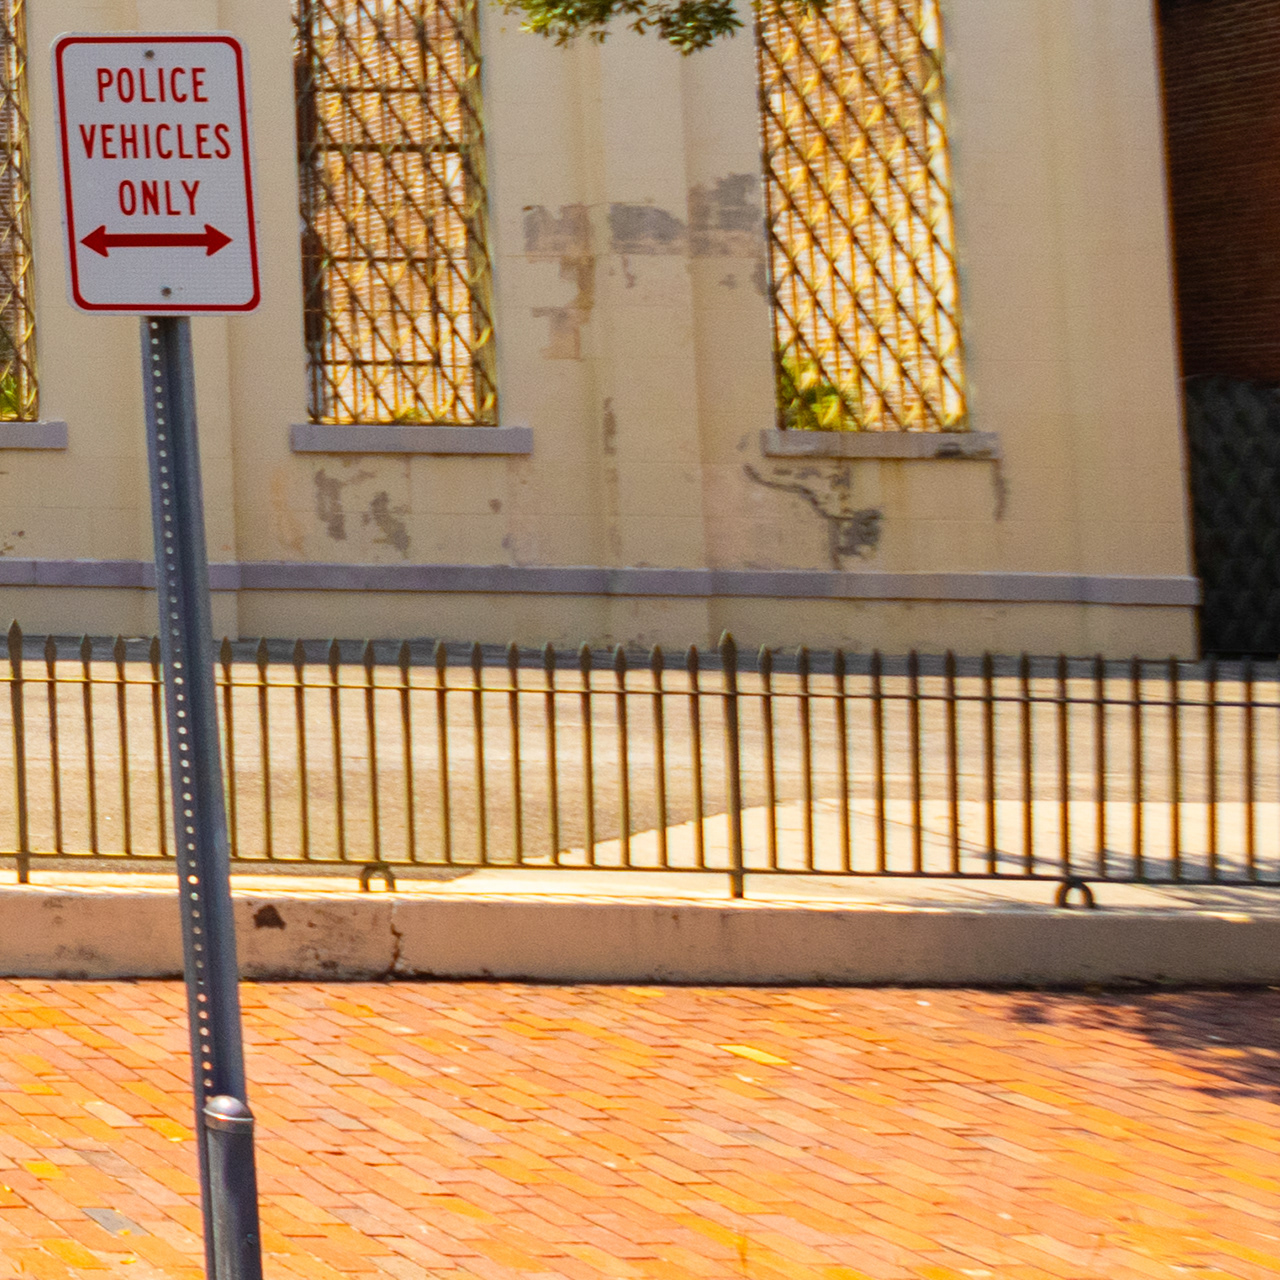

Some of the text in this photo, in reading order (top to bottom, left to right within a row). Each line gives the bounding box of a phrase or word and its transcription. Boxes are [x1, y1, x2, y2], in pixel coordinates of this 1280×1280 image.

[97, 67, 209, 103] POLICE
[78, 123, 232, 159] VEHICLES
[118, 179, 200, 216] ONLY
